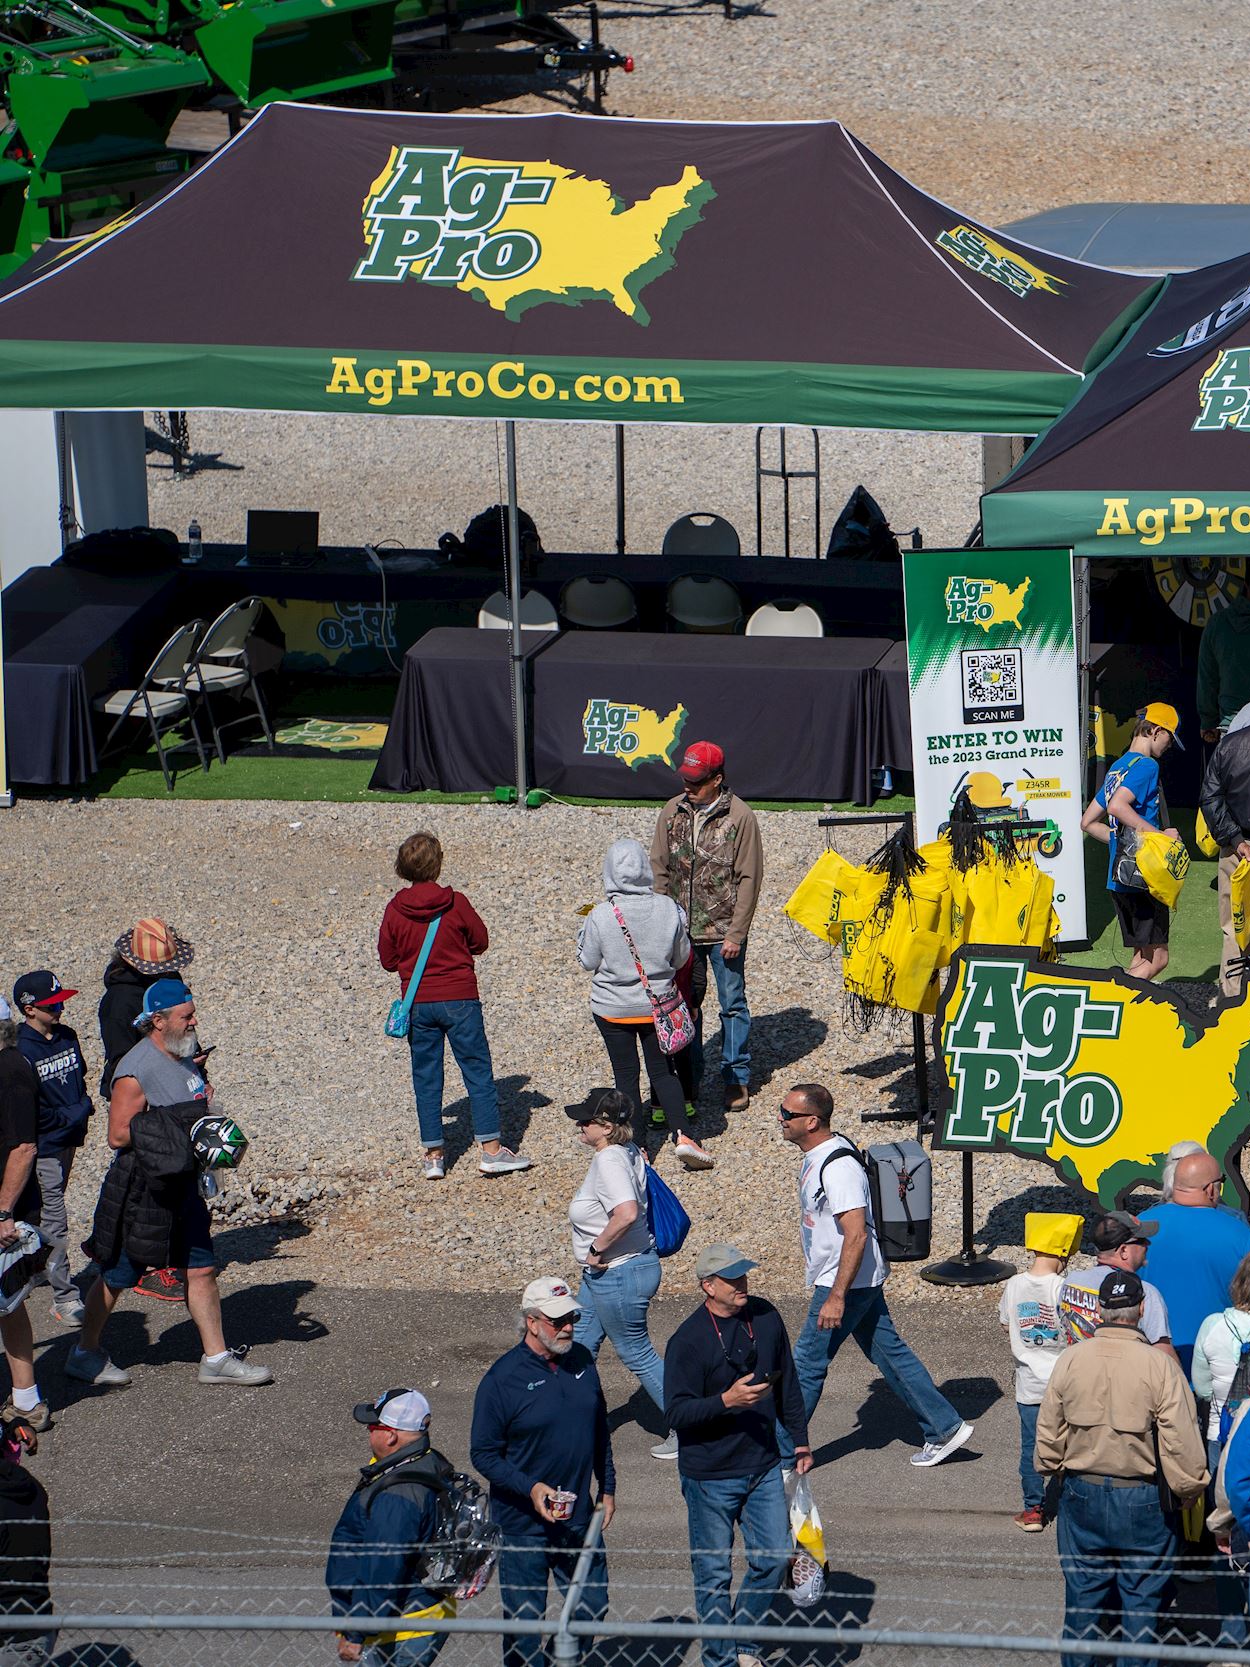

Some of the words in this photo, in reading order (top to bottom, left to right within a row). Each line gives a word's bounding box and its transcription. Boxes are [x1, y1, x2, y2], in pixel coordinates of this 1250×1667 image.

[366, 146, 555, 231] Ag-
[350, 217, 541, 282] Pro
[935, 229, 1000, 272] Ag-
[977, 256, 1036, 299] Pro
[326, 356, 685, 406] AgProCo.com
[946, 575, 992, 602] Ag-
[947, 599, 994, 624] Pro
[585, 699, 639, 733] Ag-
[973, 712, 998, 721] SCAN
[1001, 710, 1014, 719] ME
[582, 726, 639, 754] Pro
[927, 732, 987, 750] ENTER
[992, 730, 1018, 746] TO
[1023, 729, 1063, 743] WIN
[929, 754, 949, 765] the
[953, 752, 982, 763] 2023
[985, 748, 1027, 761] Grand
[1030, 747, 1063, 758] Prize
[1025, 780, 1050, 789] Z345R
[942, 957, 1125, 1075] Ag-
[942, 1051, 1123, 1147] Pro
[1111, 1284, 1126, 1295] 24
